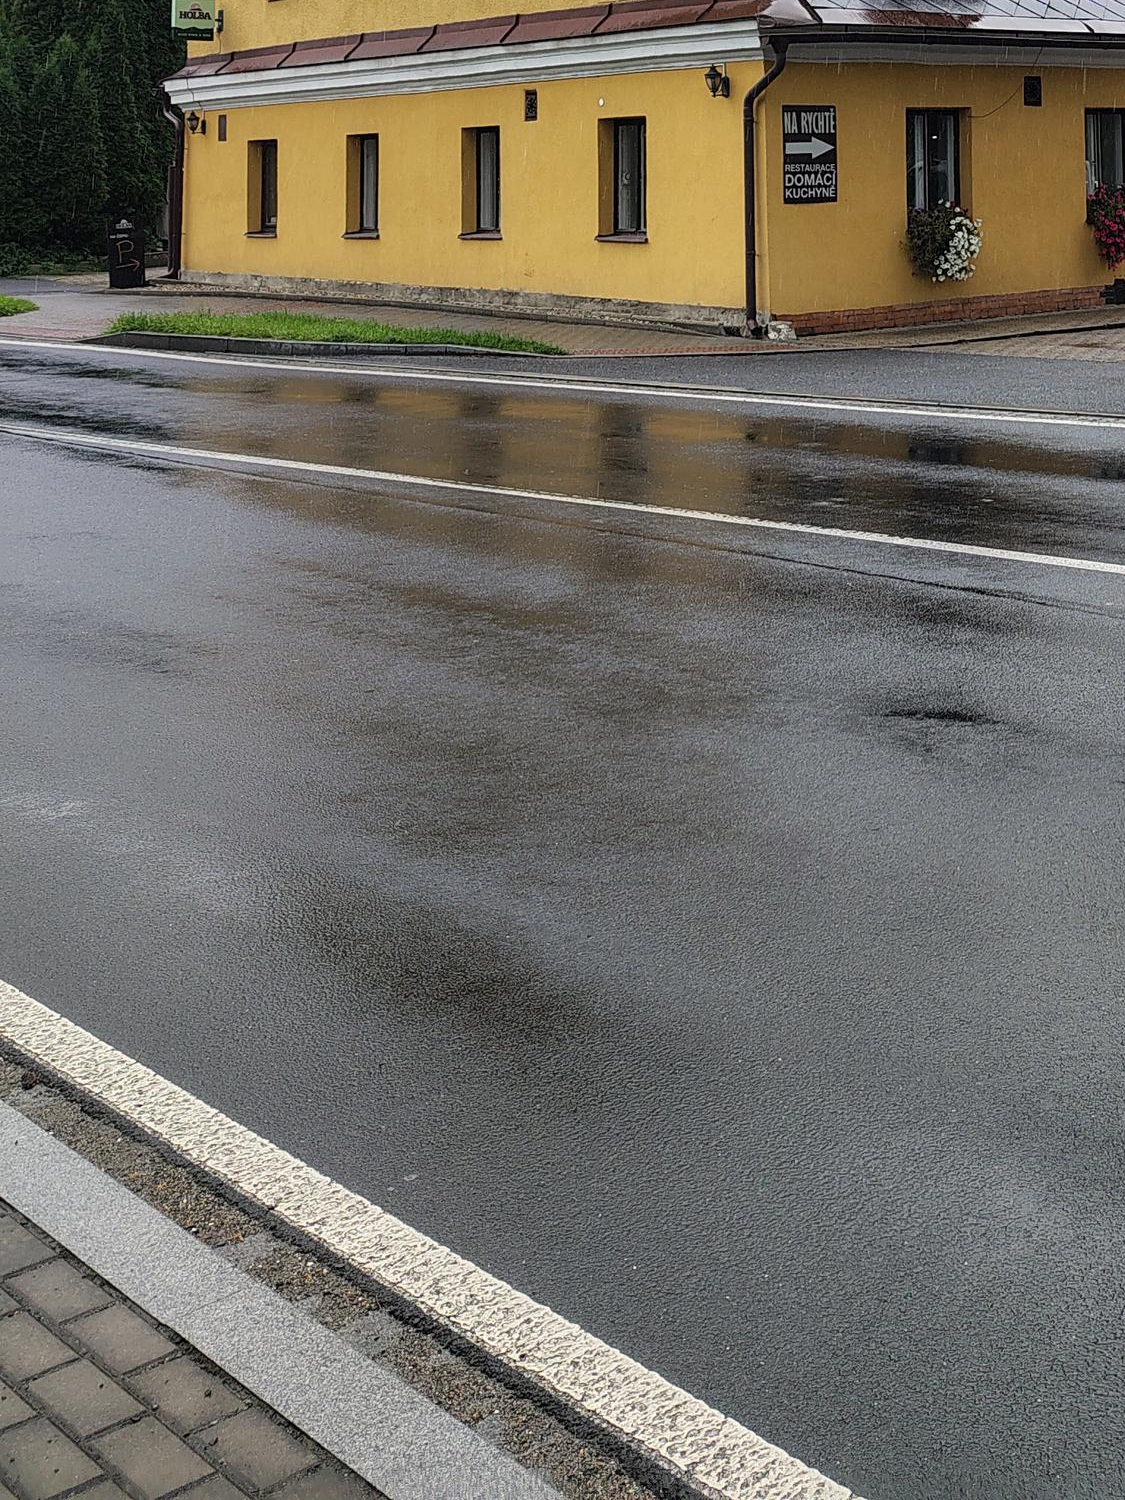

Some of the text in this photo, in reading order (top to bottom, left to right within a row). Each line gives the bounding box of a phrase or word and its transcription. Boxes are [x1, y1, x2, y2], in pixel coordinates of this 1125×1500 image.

[178, 11, 212, 20] HOLBA
[784, 108, 835, 134] NA RYCHTĚ
[785, 164, 836, 172] RESTAURACE
[785, 171, 836, 186] DOMÁCÍ
[785, 186, 836, 198] KUCHYNĚ
